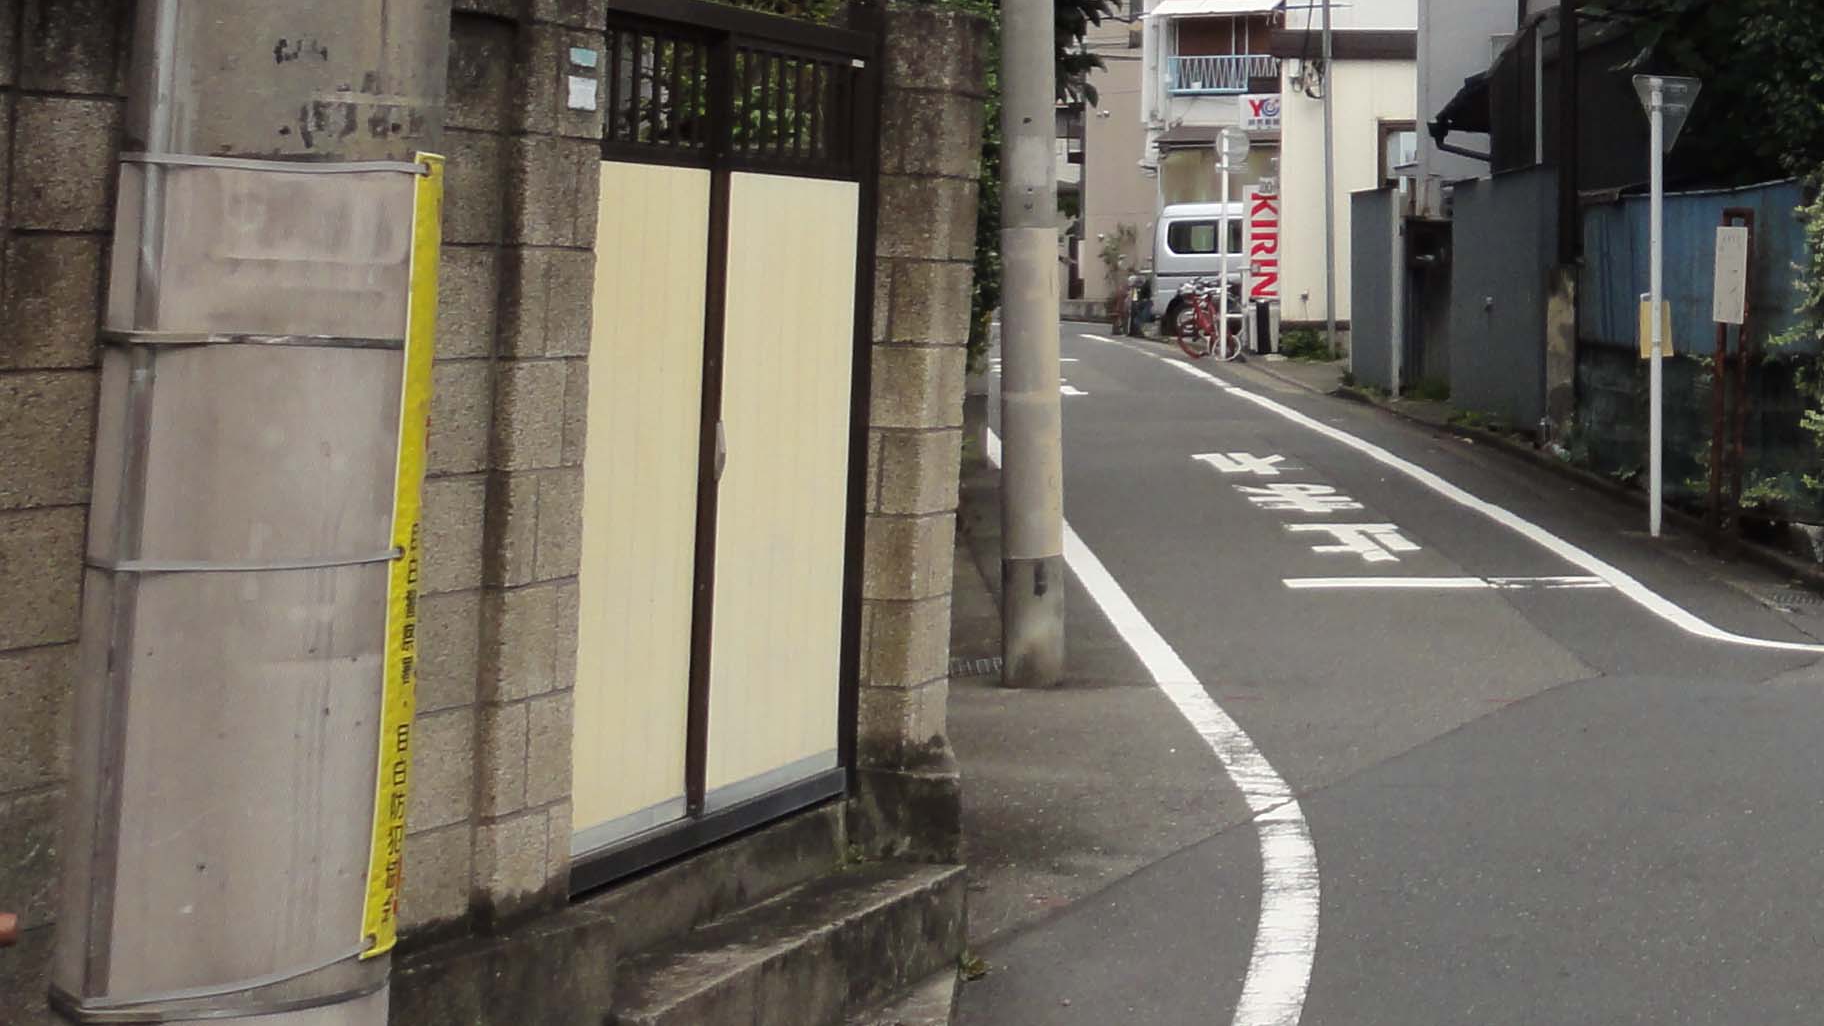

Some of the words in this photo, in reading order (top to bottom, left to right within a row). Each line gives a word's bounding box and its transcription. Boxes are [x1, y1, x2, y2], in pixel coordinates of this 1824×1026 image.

[1250, 193, 1278, 296] KIRIN
[1191, 452, 1421, 562] 止まれ
